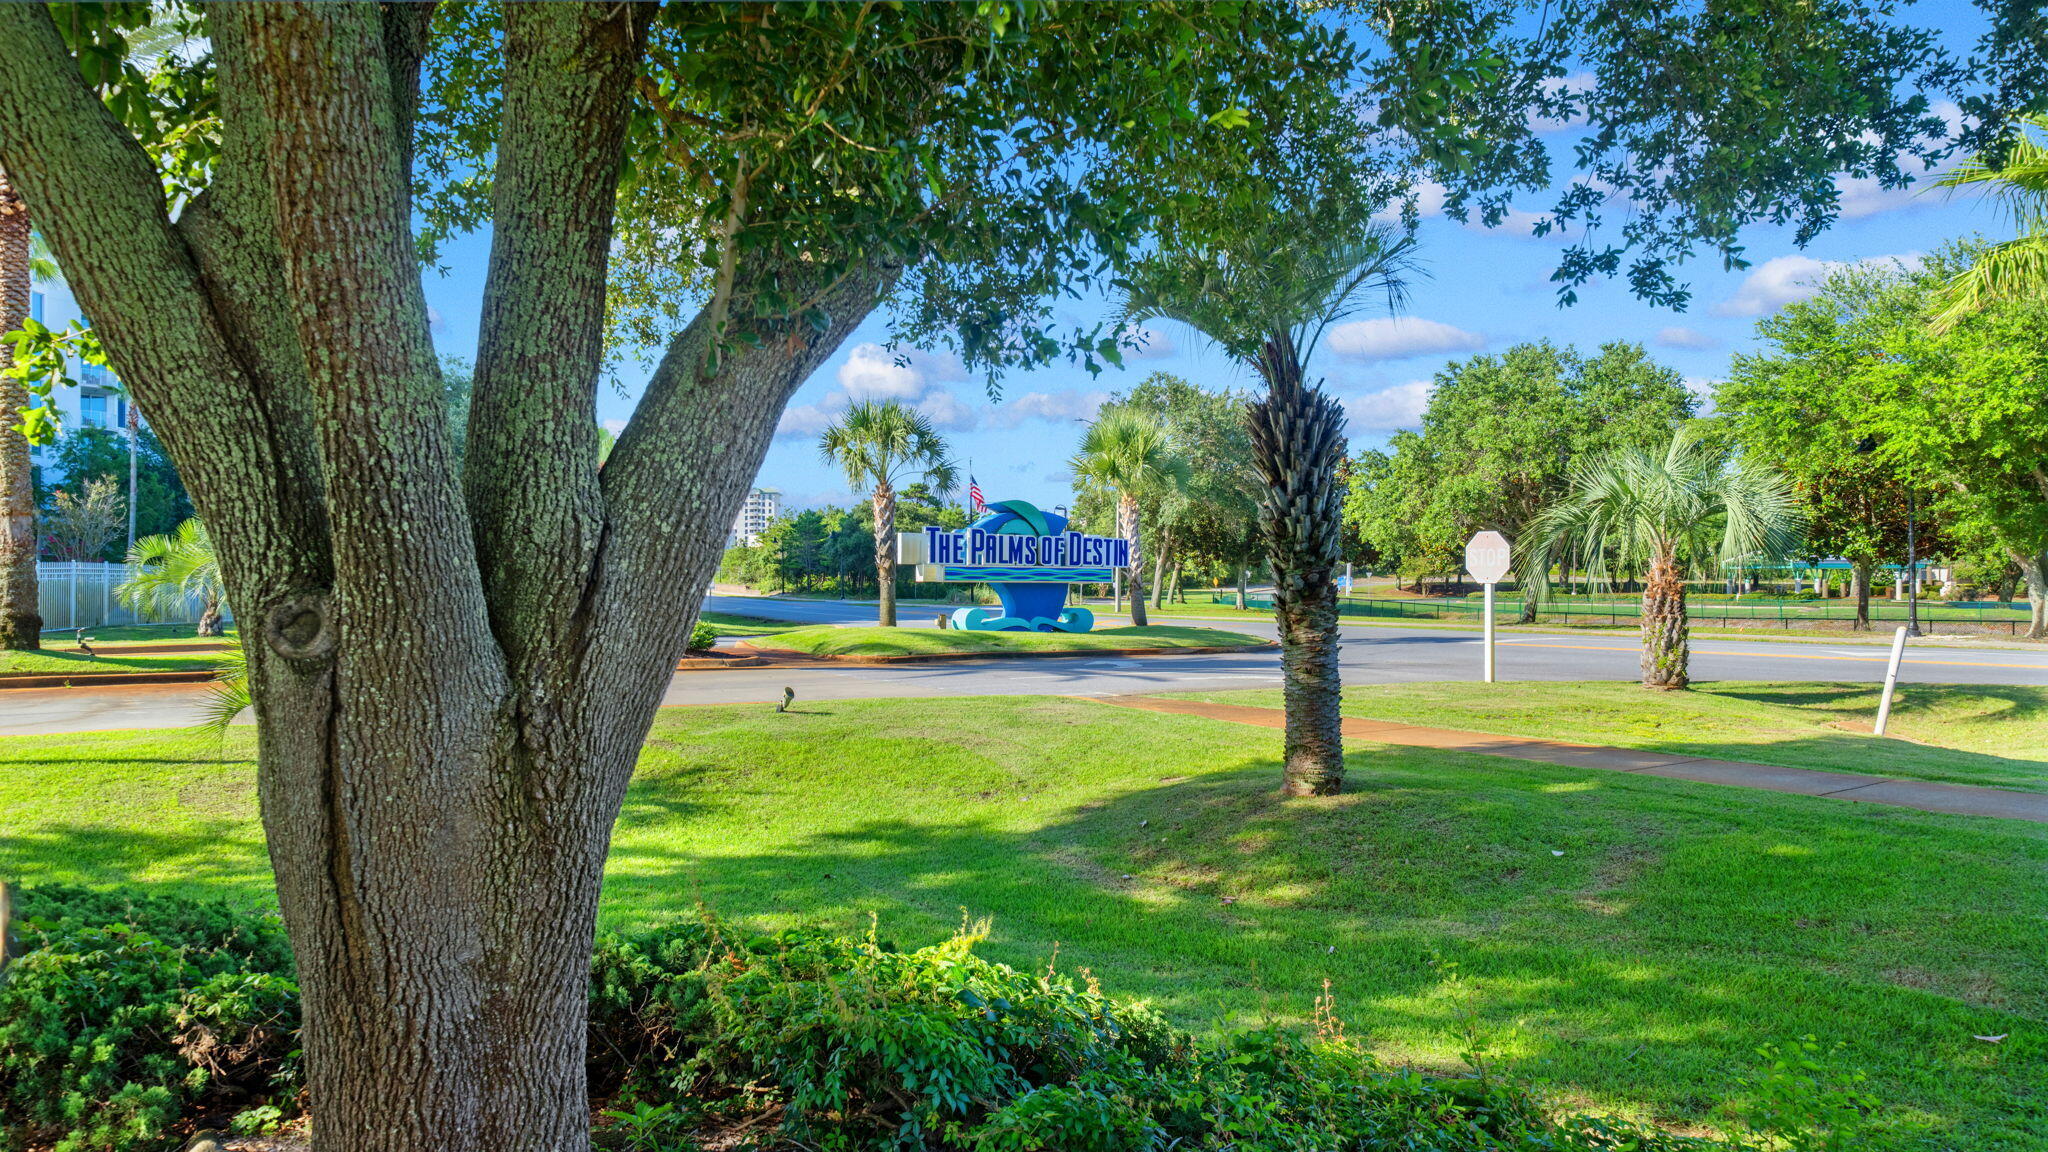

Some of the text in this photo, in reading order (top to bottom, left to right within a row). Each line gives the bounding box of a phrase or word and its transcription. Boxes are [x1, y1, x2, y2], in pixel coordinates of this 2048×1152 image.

[925, 526, 1128, 567] THE PALMS OF DESTIN
[1470, 548, 1506, 567] STOP
